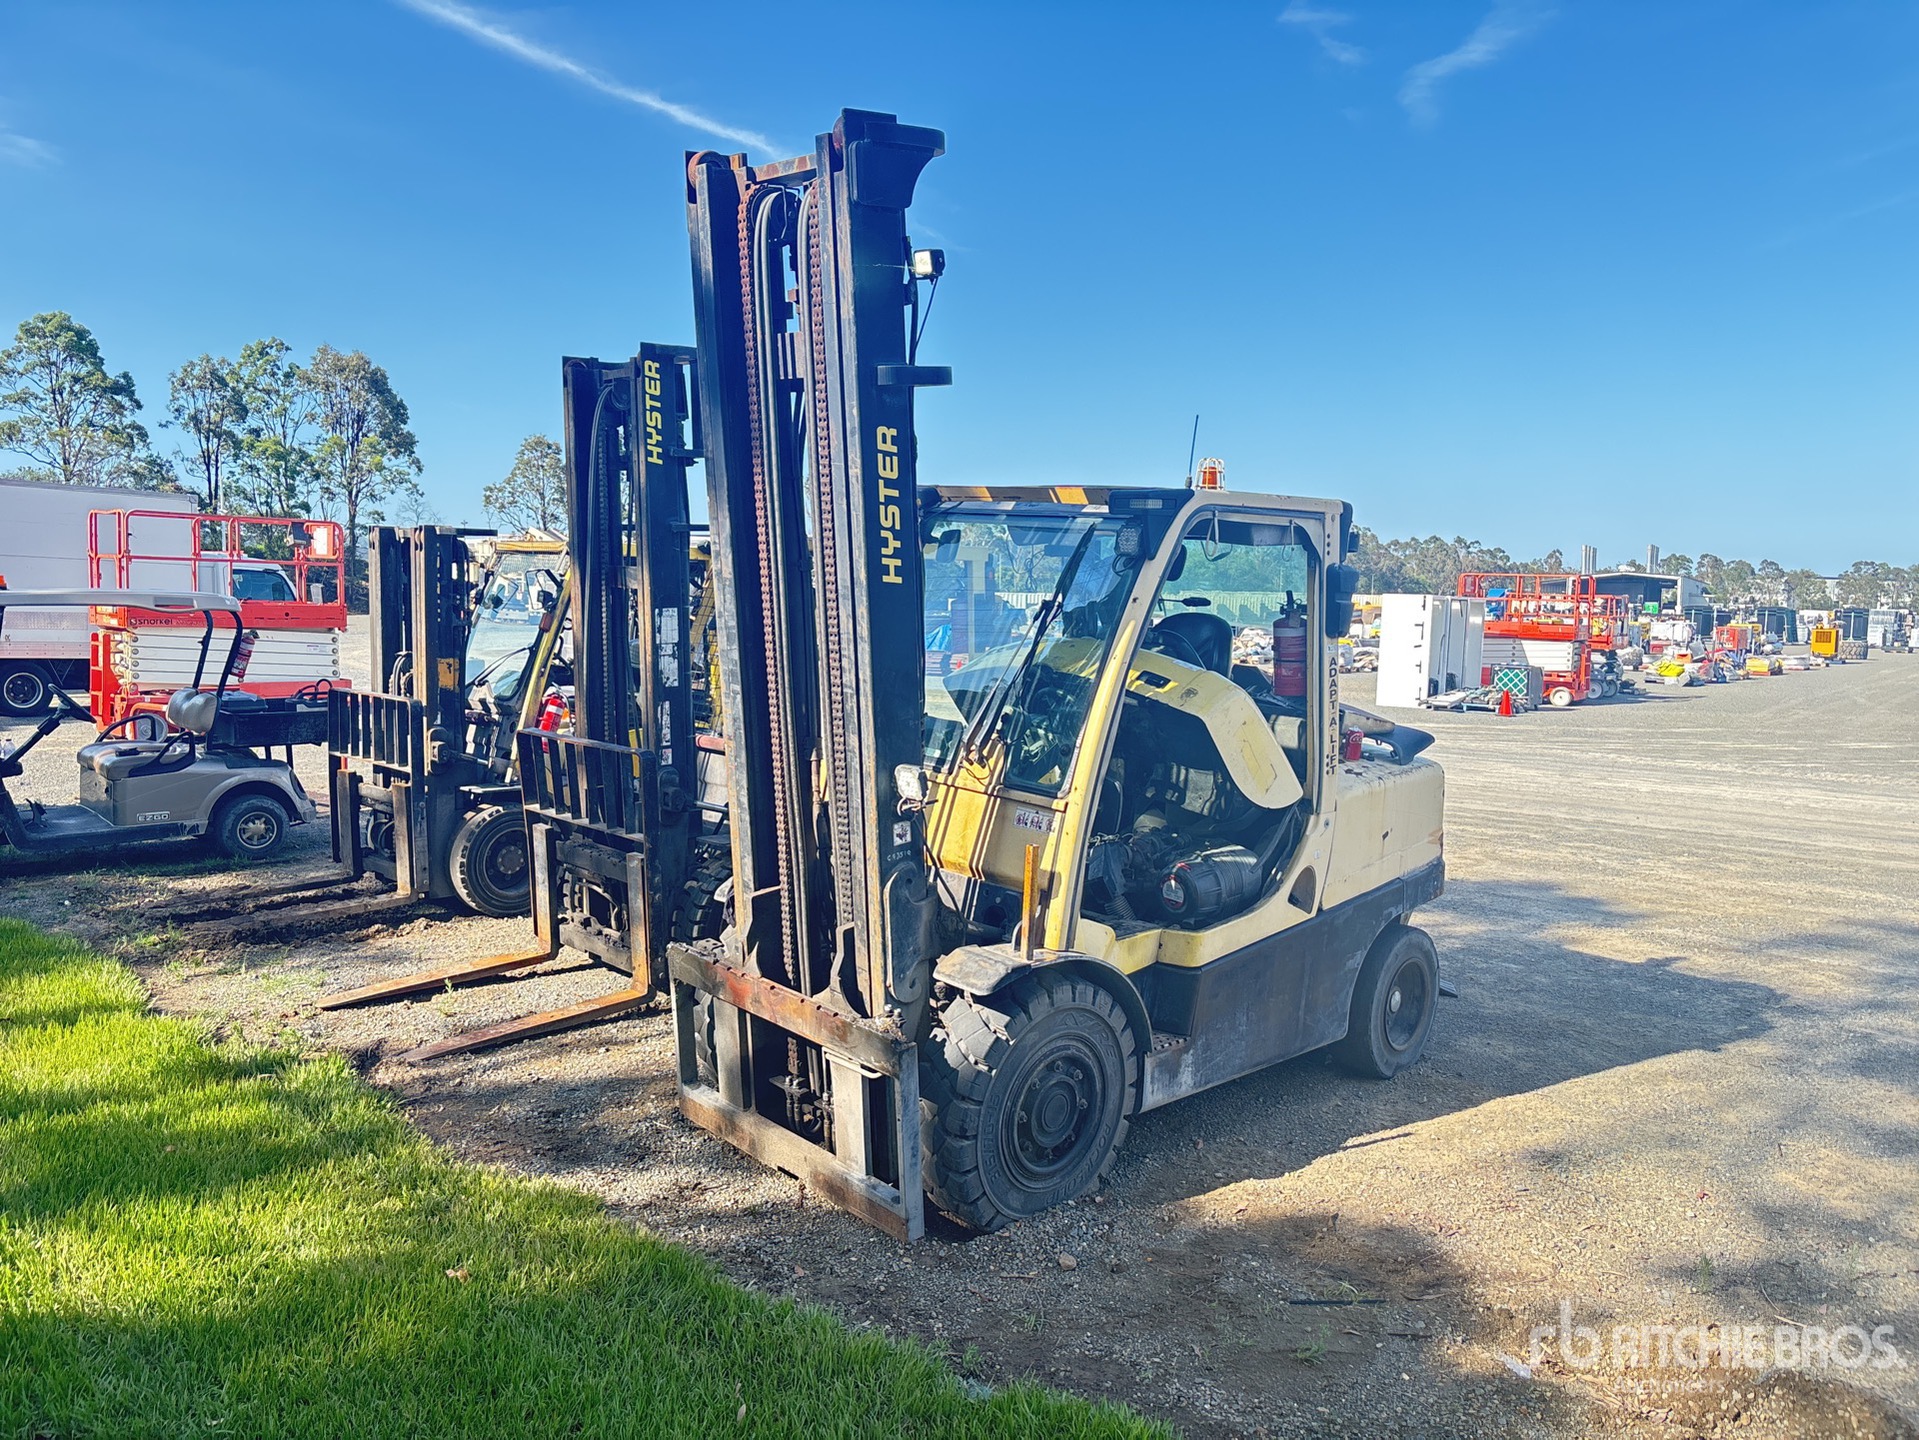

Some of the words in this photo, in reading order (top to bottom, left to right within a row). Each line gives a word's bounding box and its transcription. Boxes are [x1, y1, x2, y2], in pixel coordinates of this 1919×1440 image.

[644, 360, 663, 465] HYSTER
[876, 425, 903, 584] HYSTER
[138, 618, 173, 626] snorkel
